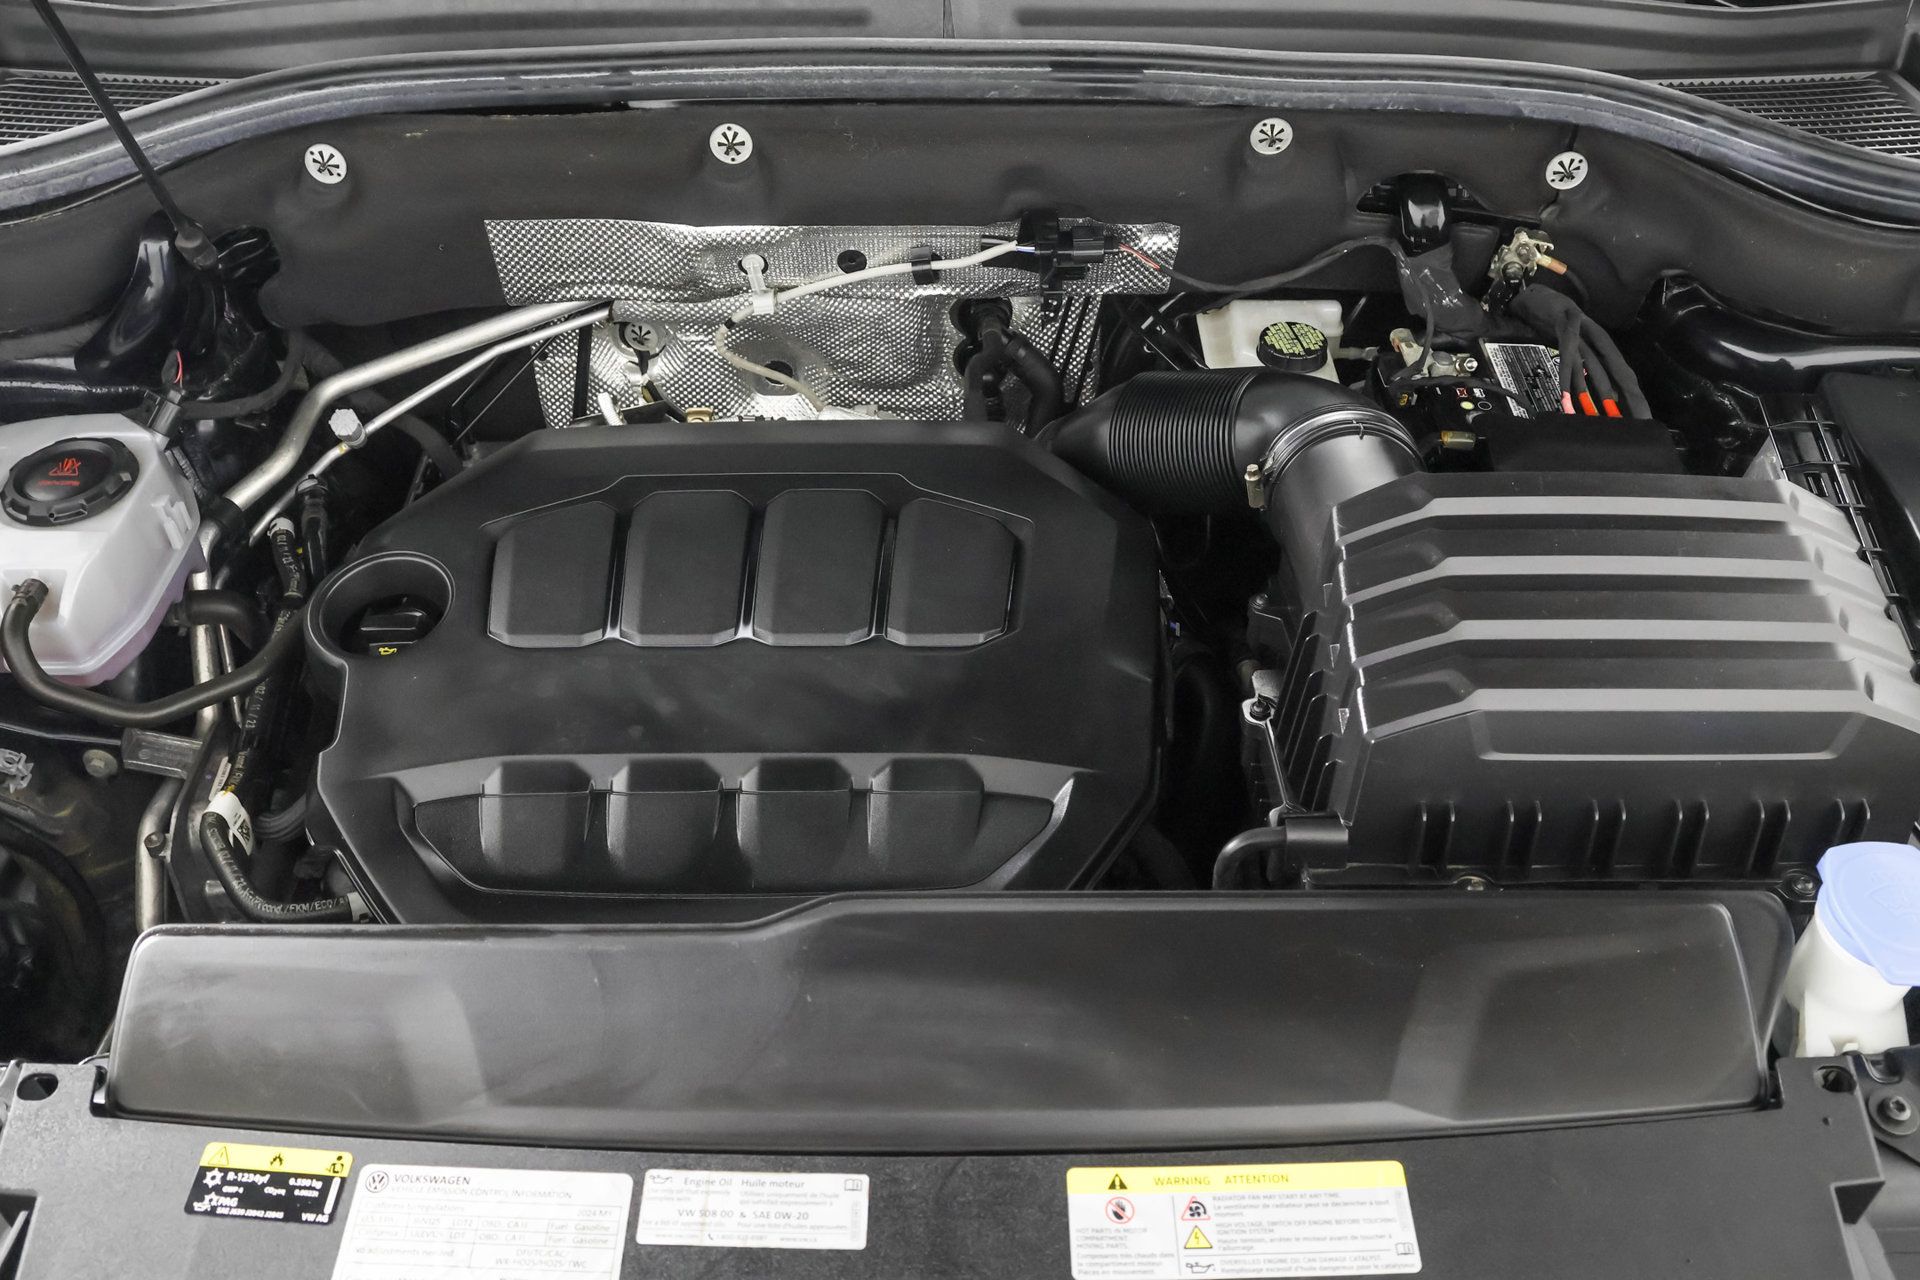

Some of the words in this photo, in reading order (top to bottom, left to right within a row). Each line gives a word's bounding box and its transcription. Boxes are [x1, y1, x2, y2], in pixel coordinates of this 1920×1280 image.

[394, 1174, 471, 1185] VOLKSWAGEN
[684, 1177, 716, 1188] Engine
[719, 1177, 733, 1186] Oil
[741, 1179, 768, 1188] Huile
[769, 1180, 806, 1189] moteur
[1154, 1176, 1211, 1186] WARNING
[1225, 1174, 1289, 1185] ATTENTION
[302, 1213, 317, 1221] VW
[316, 1214, 329, 1223] AG
[678, 1209, 696, 1217] VW
[720, 1210, 734, 1218] 00
[753, 1211, 771, 1220] SAE
[774, 1211, 809, 1220] 0W-20
[574, 1223, 610, 1232] Gasoline
[572, 1236, 608, 1245] Gasoline
